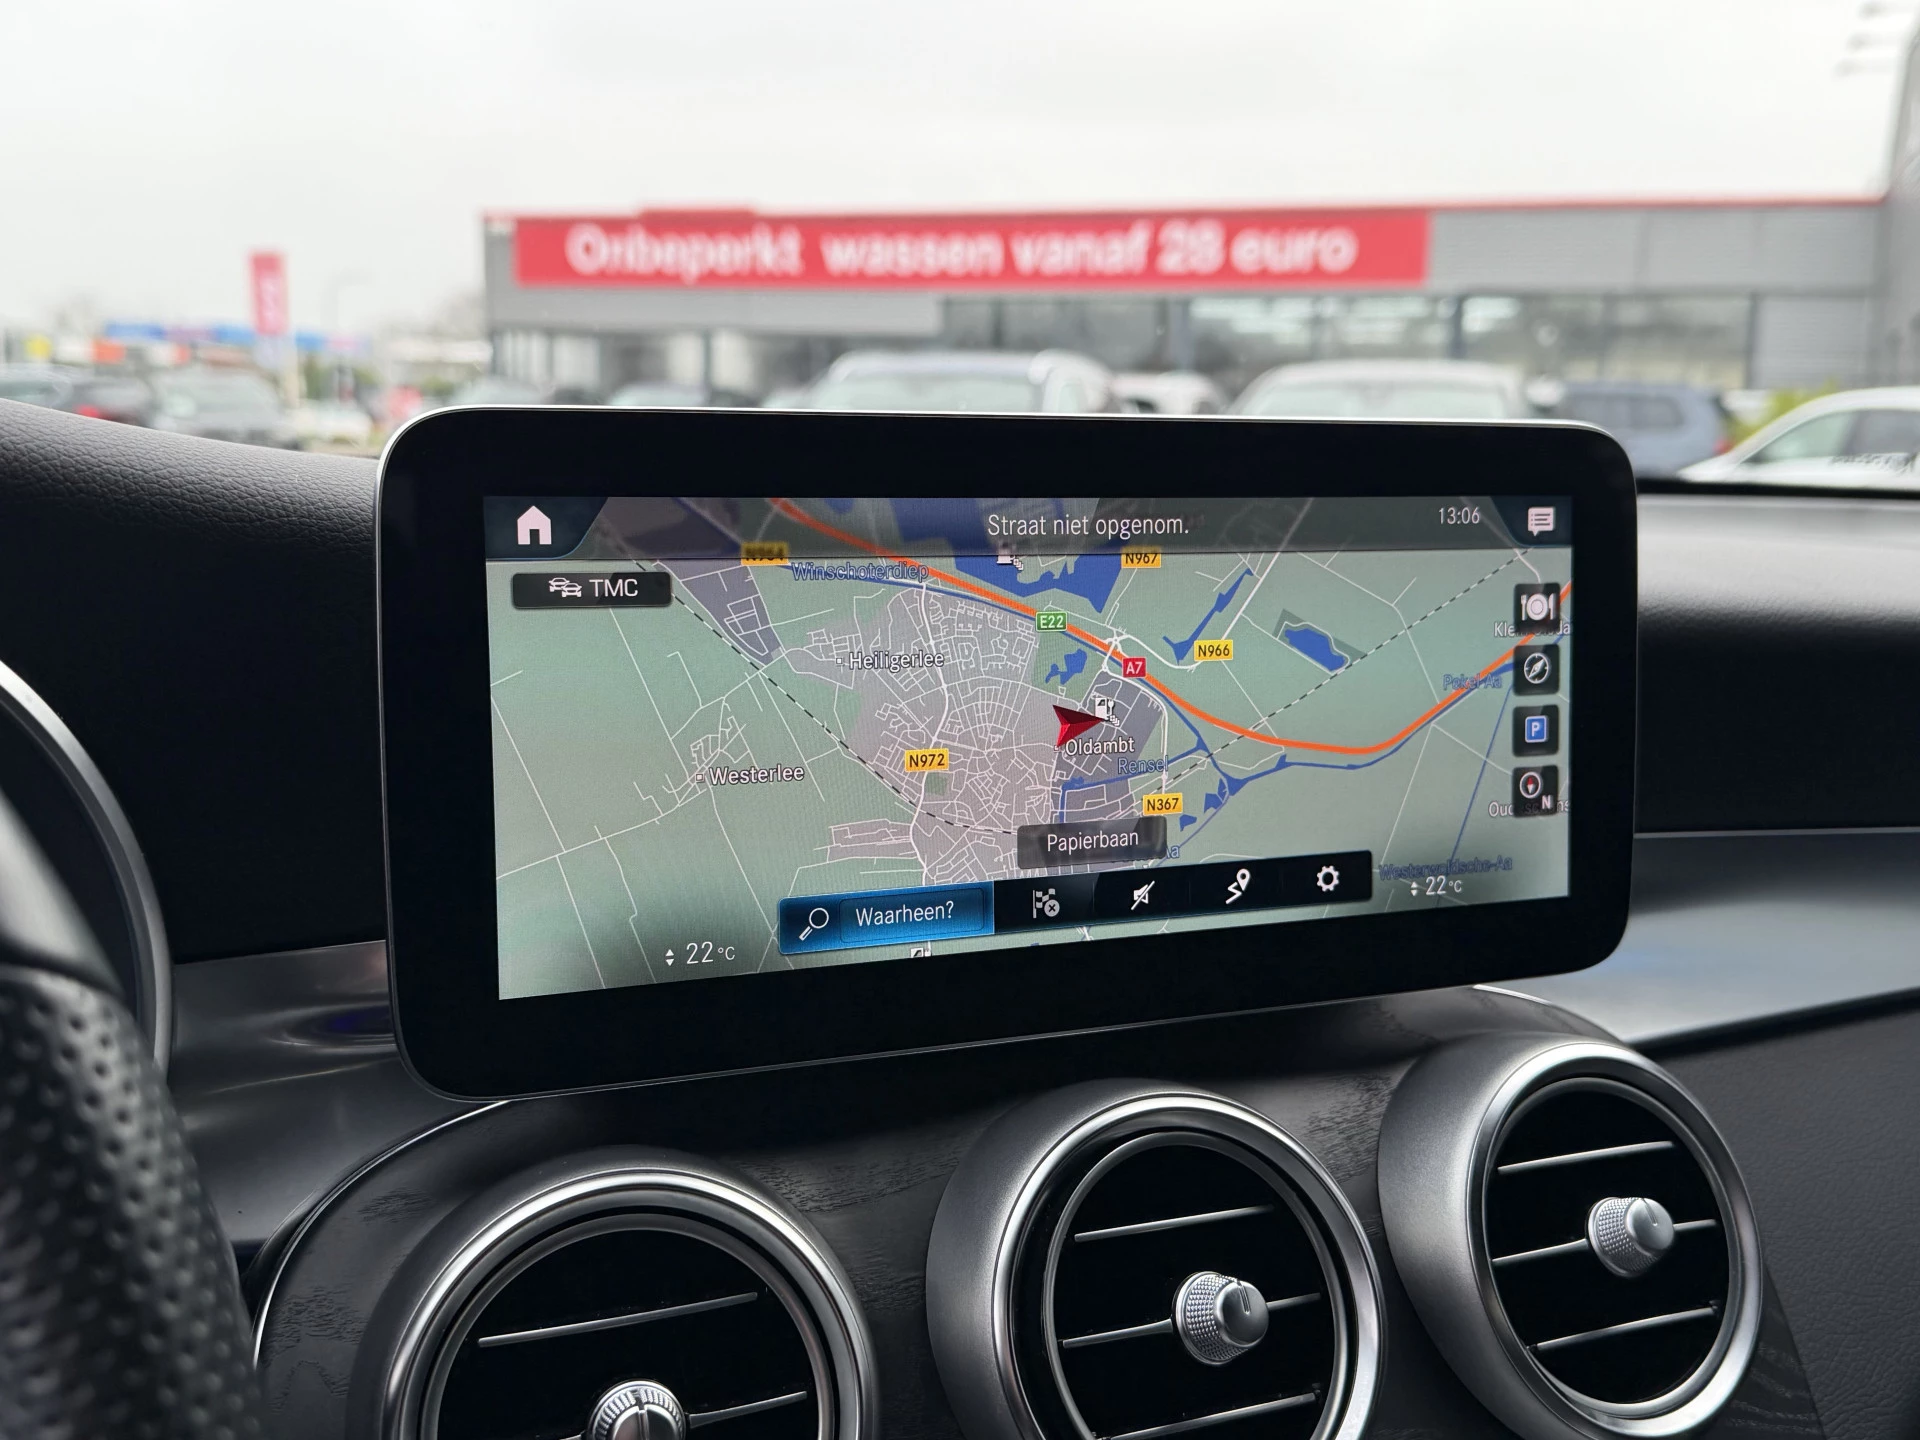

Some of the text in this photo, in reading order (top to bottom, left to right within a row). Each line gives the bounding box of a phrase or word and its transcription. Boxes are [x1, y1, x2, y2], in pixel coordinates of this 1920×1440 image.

[564, 221, 804, 283] Onbeperkt
[820, 230, 1004, 278] wassen
[1011, 220, 1153, 276] vanaf
[1229, 226, 1359, 275] euro
[1438, 507, 1480, 525] 13:06
[988, 514, 1190, 539] Straat niet opgenom.
[1125, 552, 1157, 565] N967
[791, 560, 929, 583] Winschoterdiep
[588, 578, 639, 598] TMC
[1040, 615, 1064, 629] E22
[1198, 643, 1231, 658] N966
[849, 651, 944, 672] Heiligerlee
[1126, 660, 1143, 675] A7
[1065, 737, 1135, 755] Oldambt
[909, 753, 946, 768] N972
[1118, 755, 1168, 774] Rensel
[709, 764, 805, 786] Westerlee
[1146, 796, 1180, 812] N367
[1046, 830, 1140, 853] Papierbaan
[855, 900, 955, 927] Waarheen?
